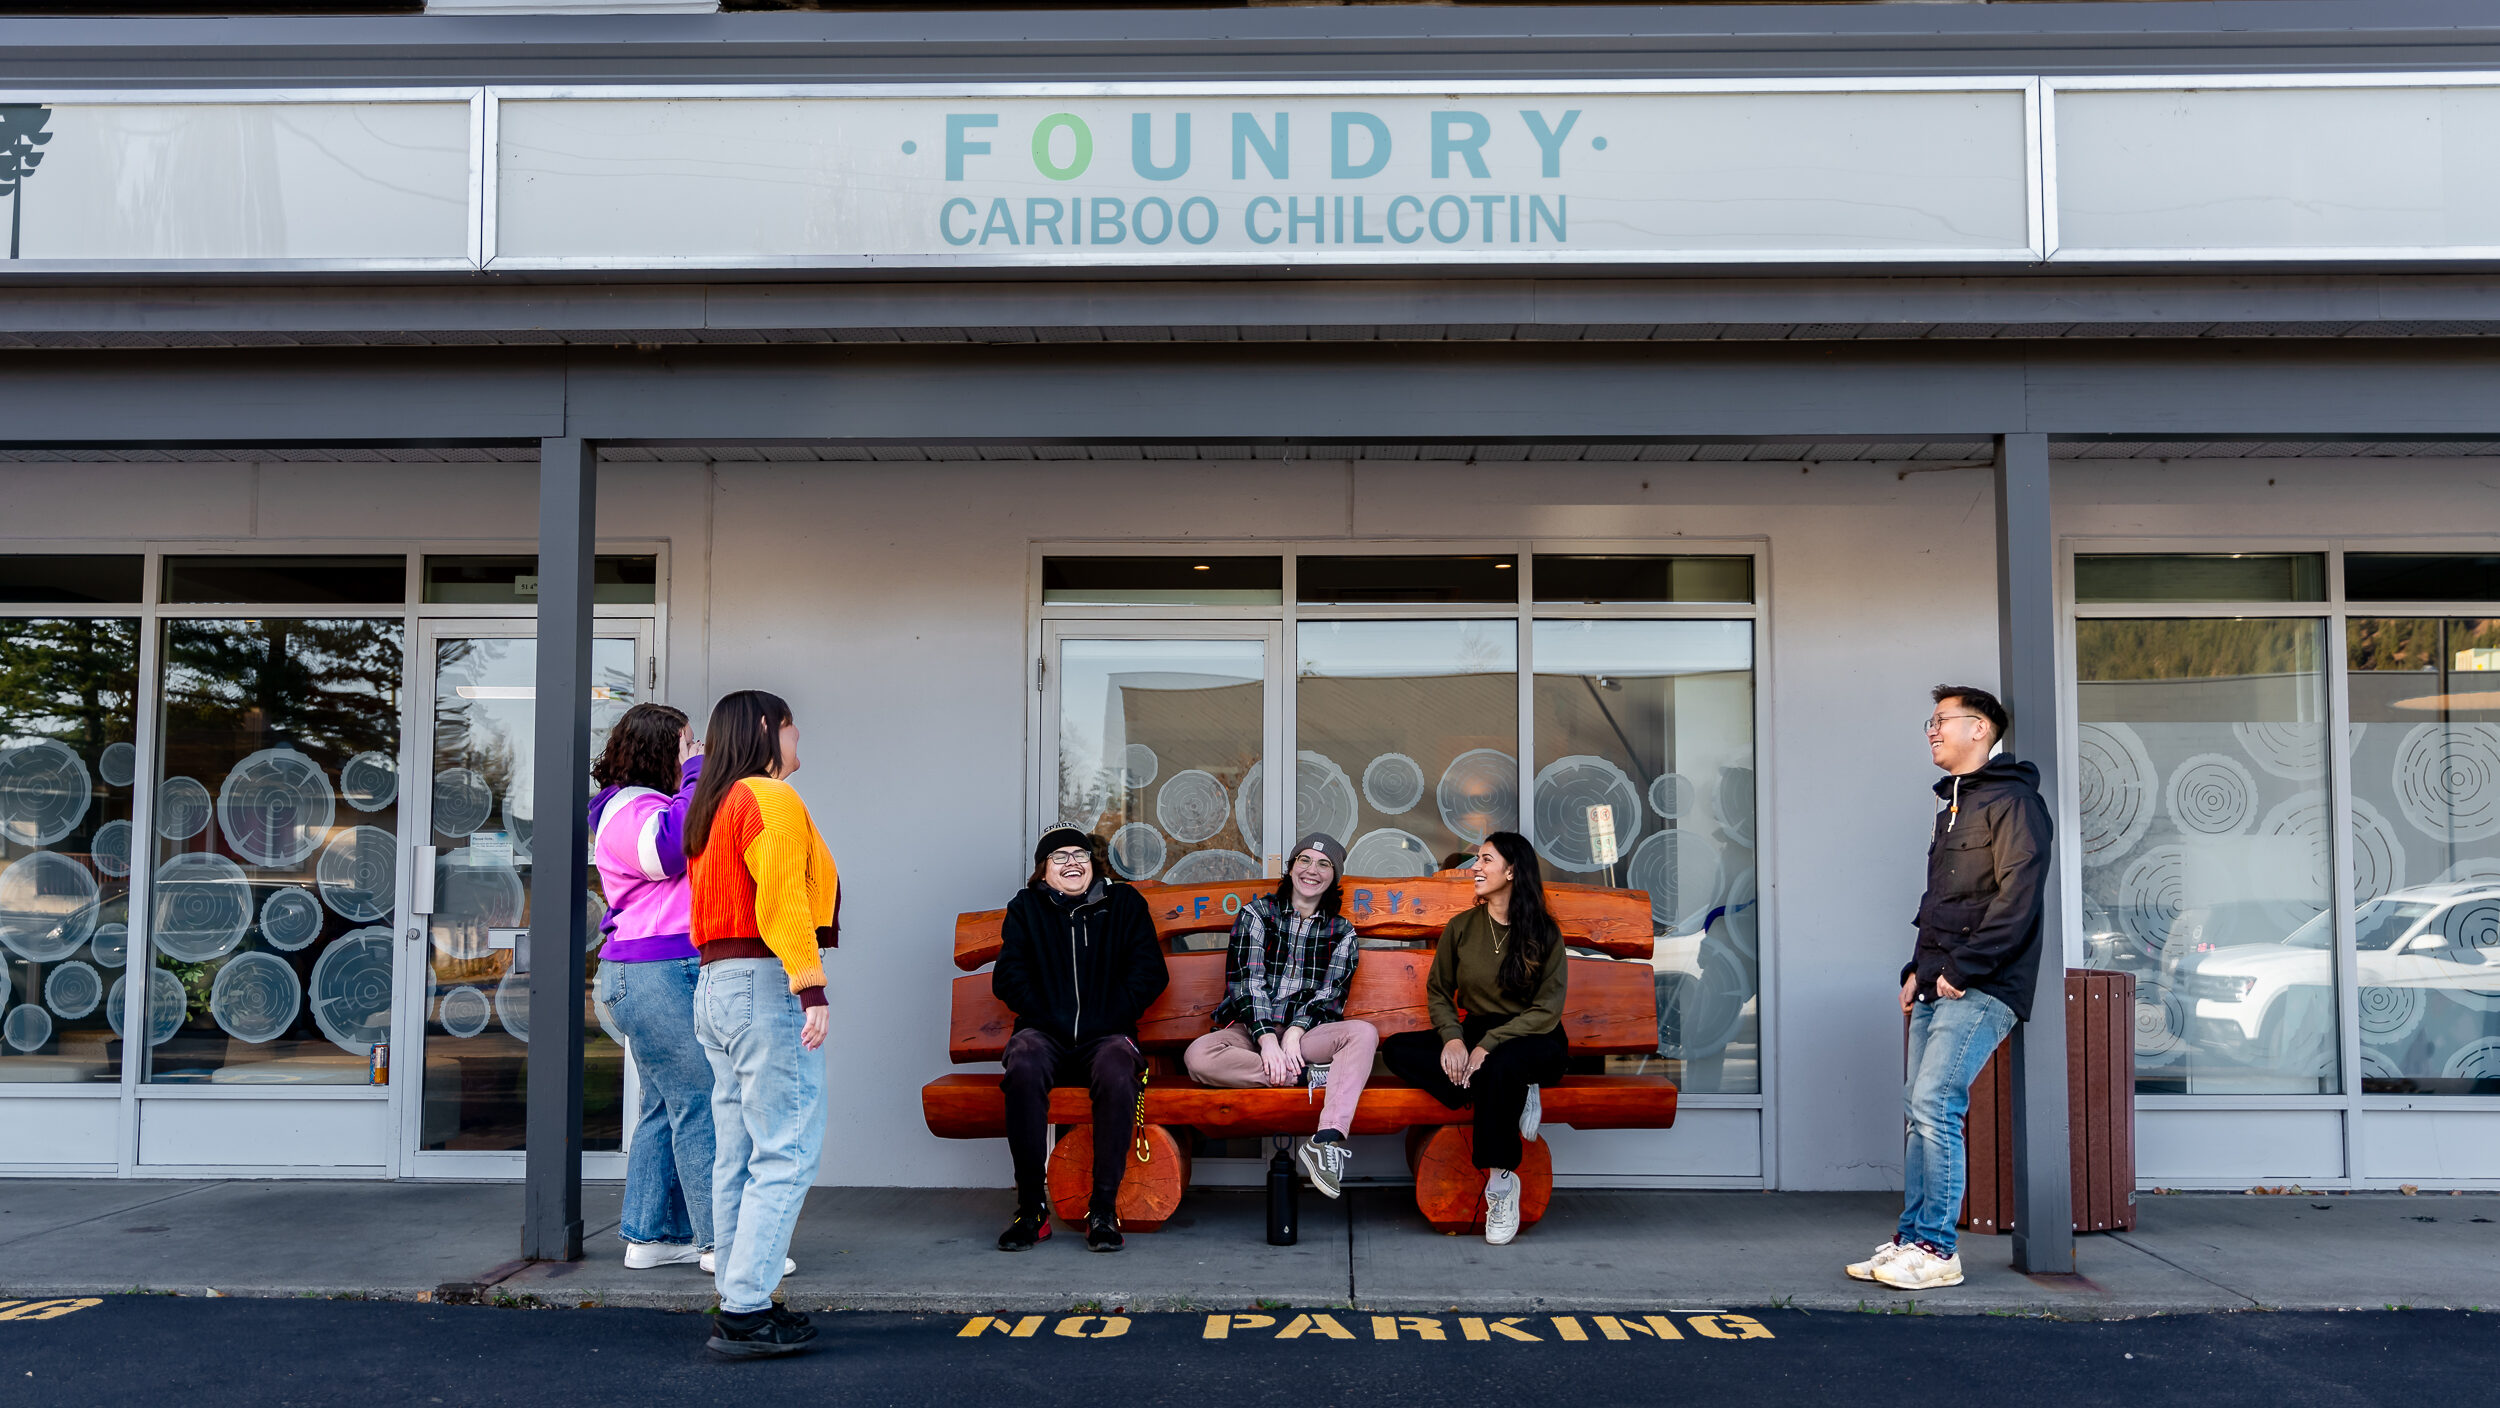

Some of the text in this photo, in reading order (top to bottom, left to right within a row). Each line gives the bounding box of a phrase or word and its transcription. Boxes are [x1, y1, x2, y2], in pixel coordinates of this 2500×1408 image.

[945, 109, 1583, 182] FOUNDRY
[939, 194, 1568, 246] CARIBOO CHILCOTIN
[1194, 888, 1404, 919] FORY
[954, 1313, 1777, 1342] NO PARKING
